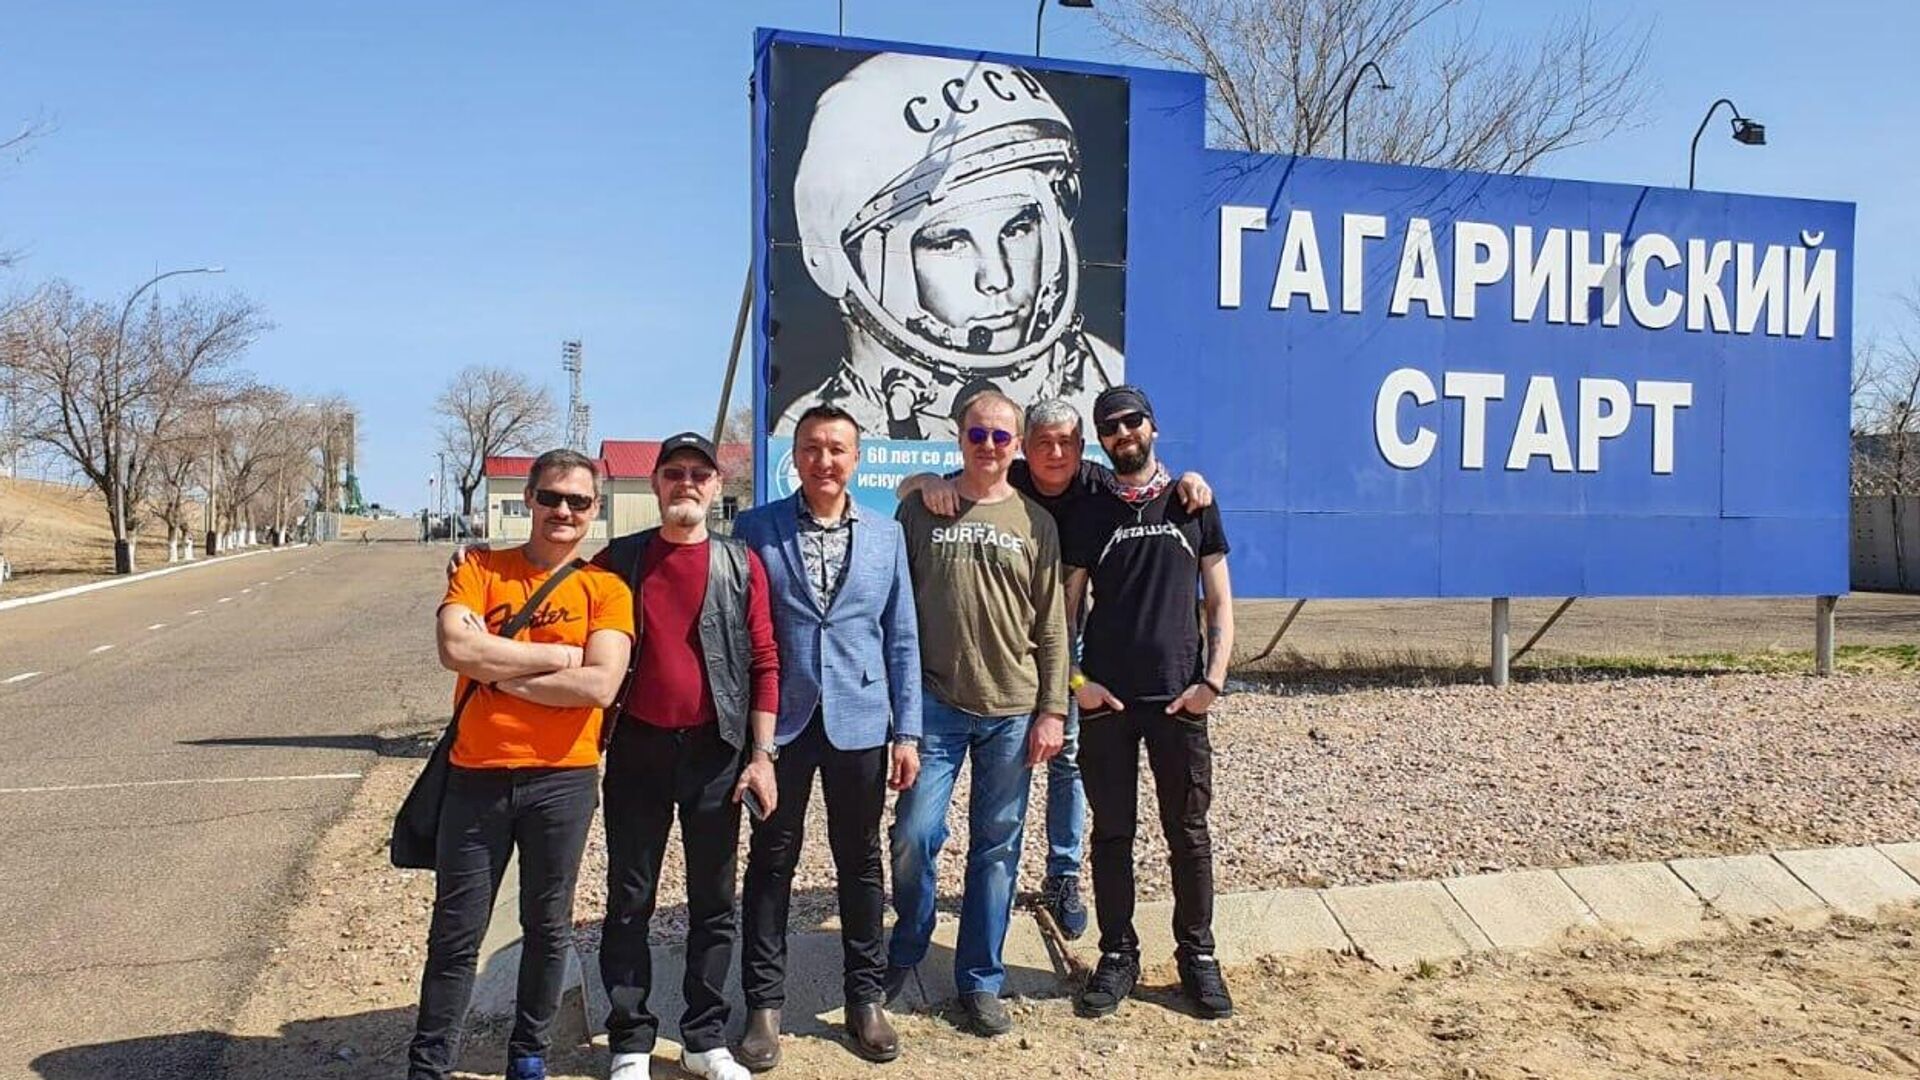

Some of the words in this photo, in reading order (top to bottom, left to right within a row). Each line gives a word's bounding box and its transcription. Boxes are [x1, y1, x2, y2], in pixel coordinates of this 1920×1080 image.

[903, 69, 1048, 133] СССР
[1218, 205, 1837, 338] ГАГАРИНСКИЙ
[1374, 368, 1692, 474] СТАРТ
[866, 446, 888, 465] 60
[890, 449, 918, 465] лет
[921, 451, 940, 466] со
[942, 451, 964, 468] дн
[857, 472, 903, 490] искус
[931, 527, 1025, 553] SURFACE
[484, 601, 583, 634] Fder
